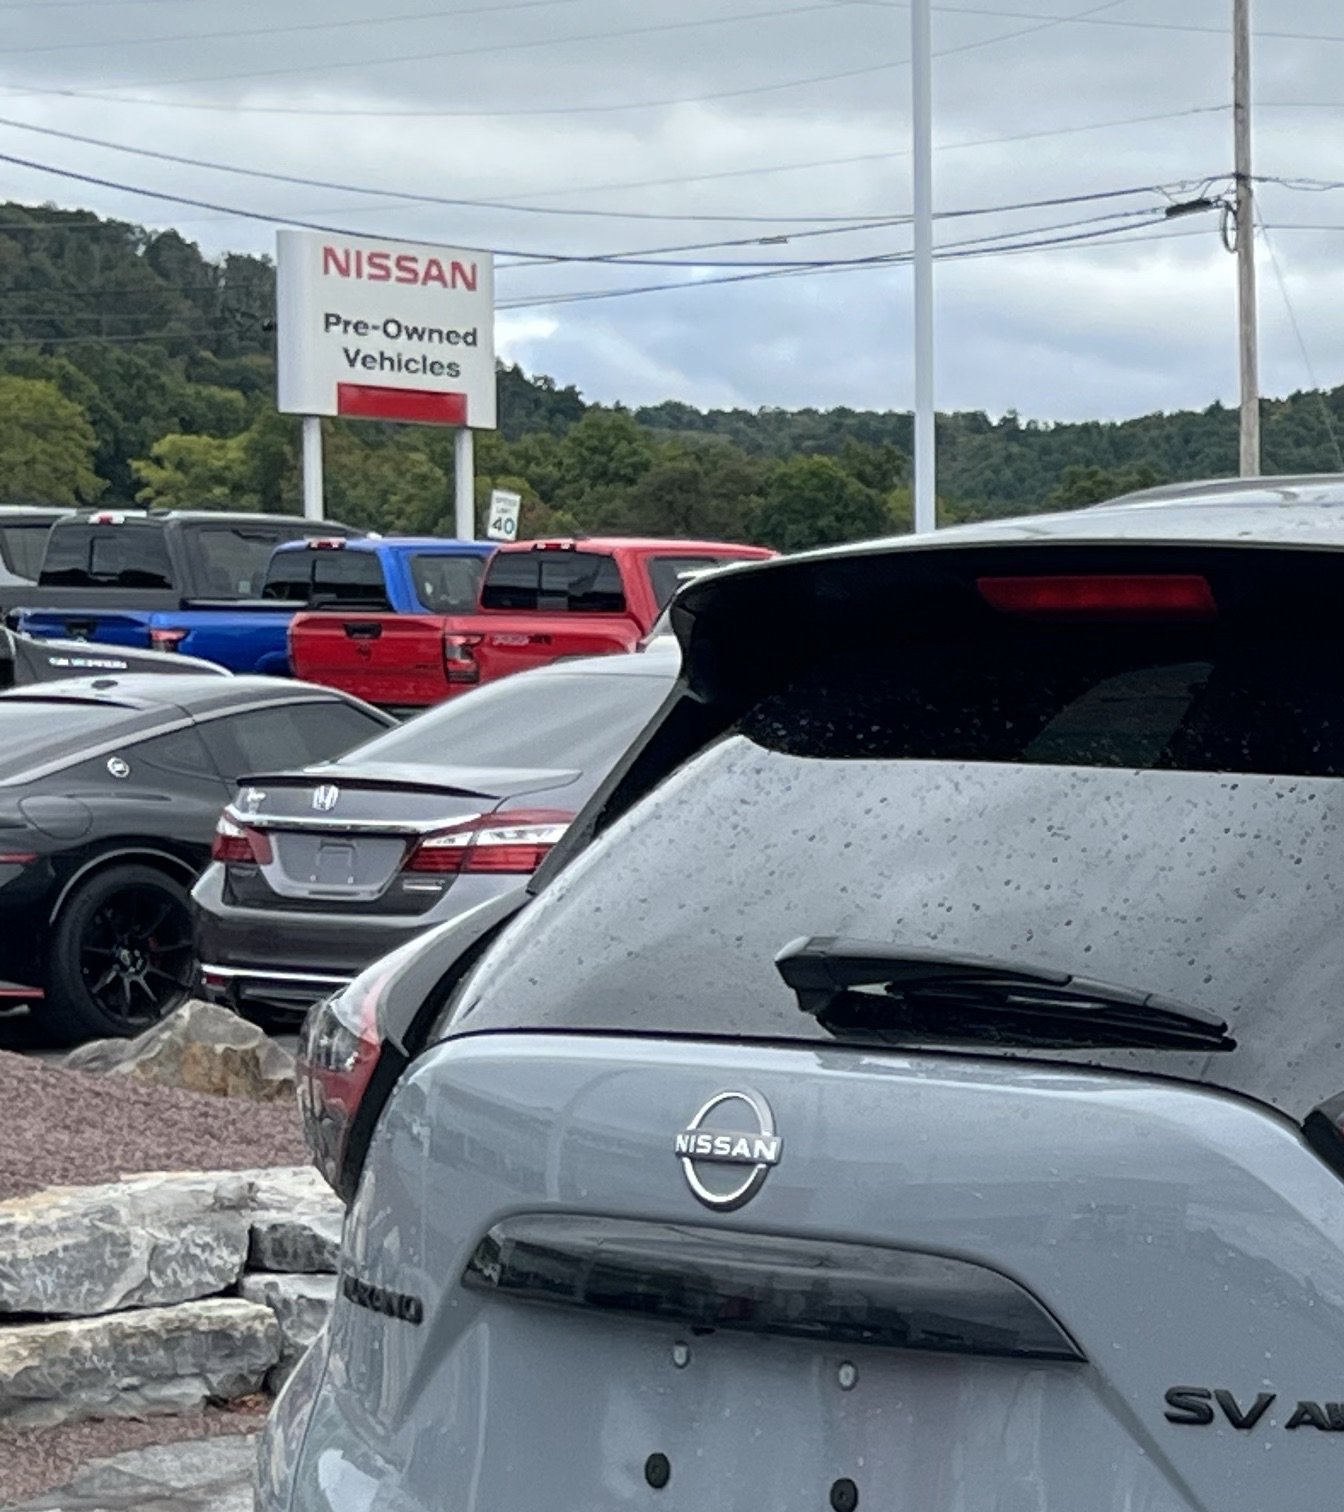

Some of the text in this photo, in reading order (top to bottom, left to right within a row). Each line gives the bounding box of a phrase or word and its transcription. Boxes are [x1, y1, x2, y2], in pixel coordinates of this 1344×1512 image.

[323, 246, 477, 292] NISSAN
[324, 312, 478, 347] Pre-Owned
[342, 347, 461, 378] Vehicles
[491, 517, 515, 535] 40
[675, 1134, 777, 1161] NISSAN
[1164, 1386, 1277, 1430] SV
